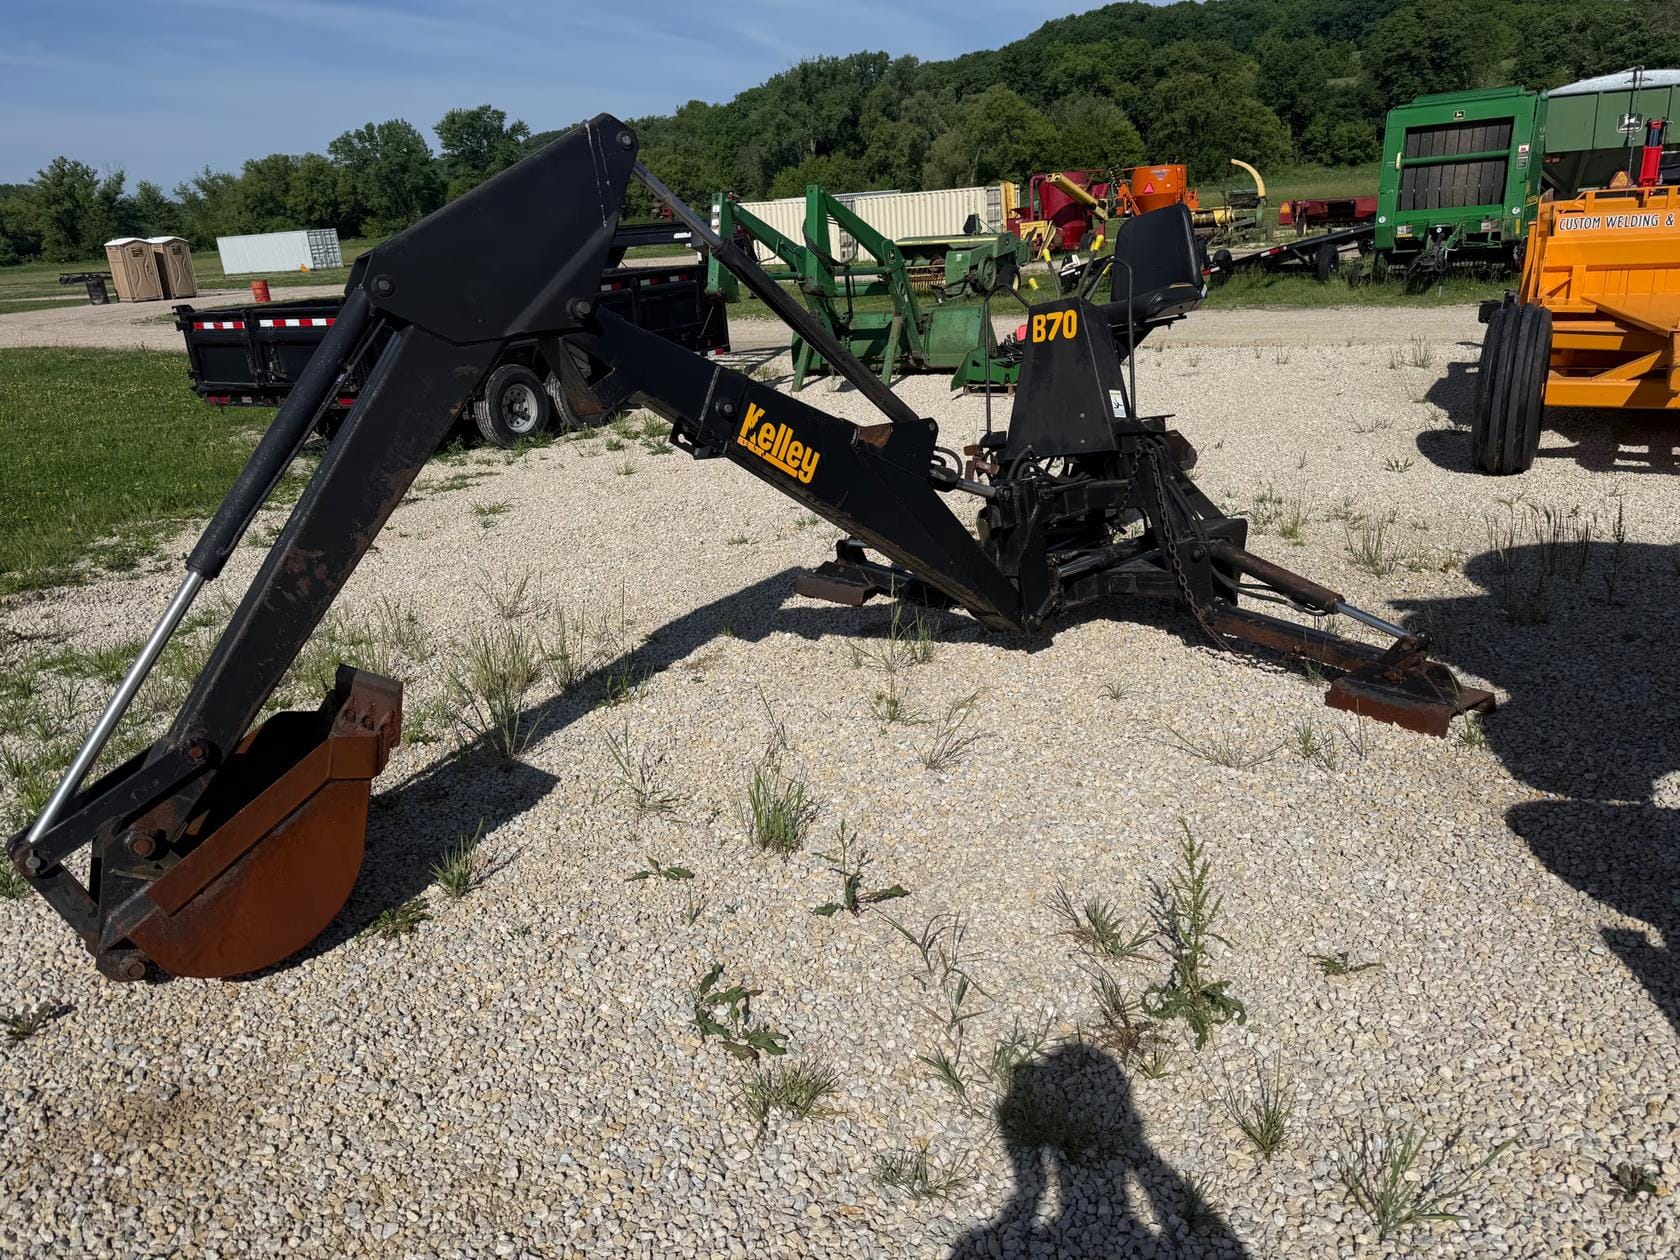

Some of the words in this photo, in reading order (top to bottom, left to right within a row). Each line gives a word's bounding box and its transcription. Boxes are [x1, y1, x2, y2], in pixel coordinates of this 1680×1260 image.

[1559, 216, 1601, 230] CUSTOM
[1606, 214, 1659, 228] WELDING
[1665, 213, 1674, 226] &
[1032, 309, 1078, 343] B70
[738, 402, 821, 484] Kelley
